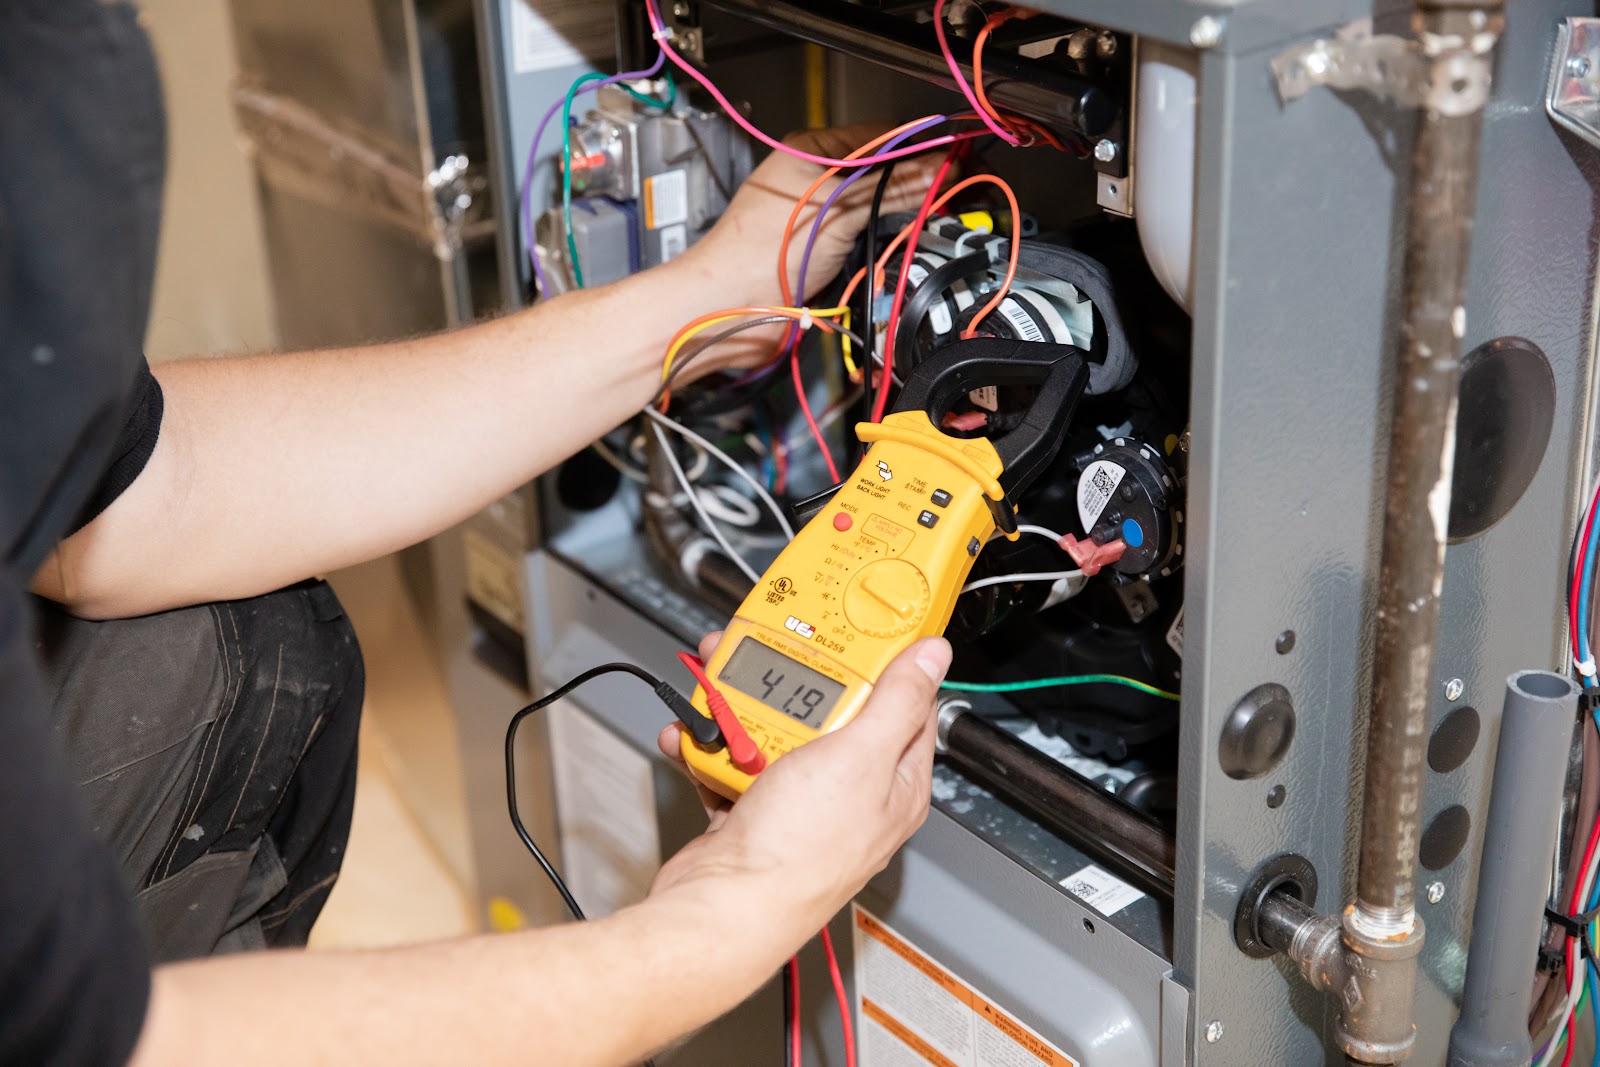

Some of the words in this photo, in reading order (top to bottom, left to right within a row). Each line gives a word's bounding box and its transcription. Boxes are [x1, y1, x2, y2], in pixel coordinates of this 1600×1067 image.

[860, 478, 875, 488] WORK
[876, 484, 891, 494] LIGHT
[913, 477, 928, 488] TIME
[856, 484, 870, 494] BACK
[870, 490, 886, 500] LIGHT
[840, 502, 859, 514] MODE
[898, 502, 912, 512] REC
[860, 536, 877, 546] TEMP
[767, 590, 785, 602] LISTED
[756, 632, 771, 644] TRUE
[774, 640, 787, 650] RMS
[788, 648, 810, 662] DIGITAL
[815, 634, 846, 654] DL259
[762, 668, 824, 720] 41.9
[1040, 1046, 1054, 1058] AND
